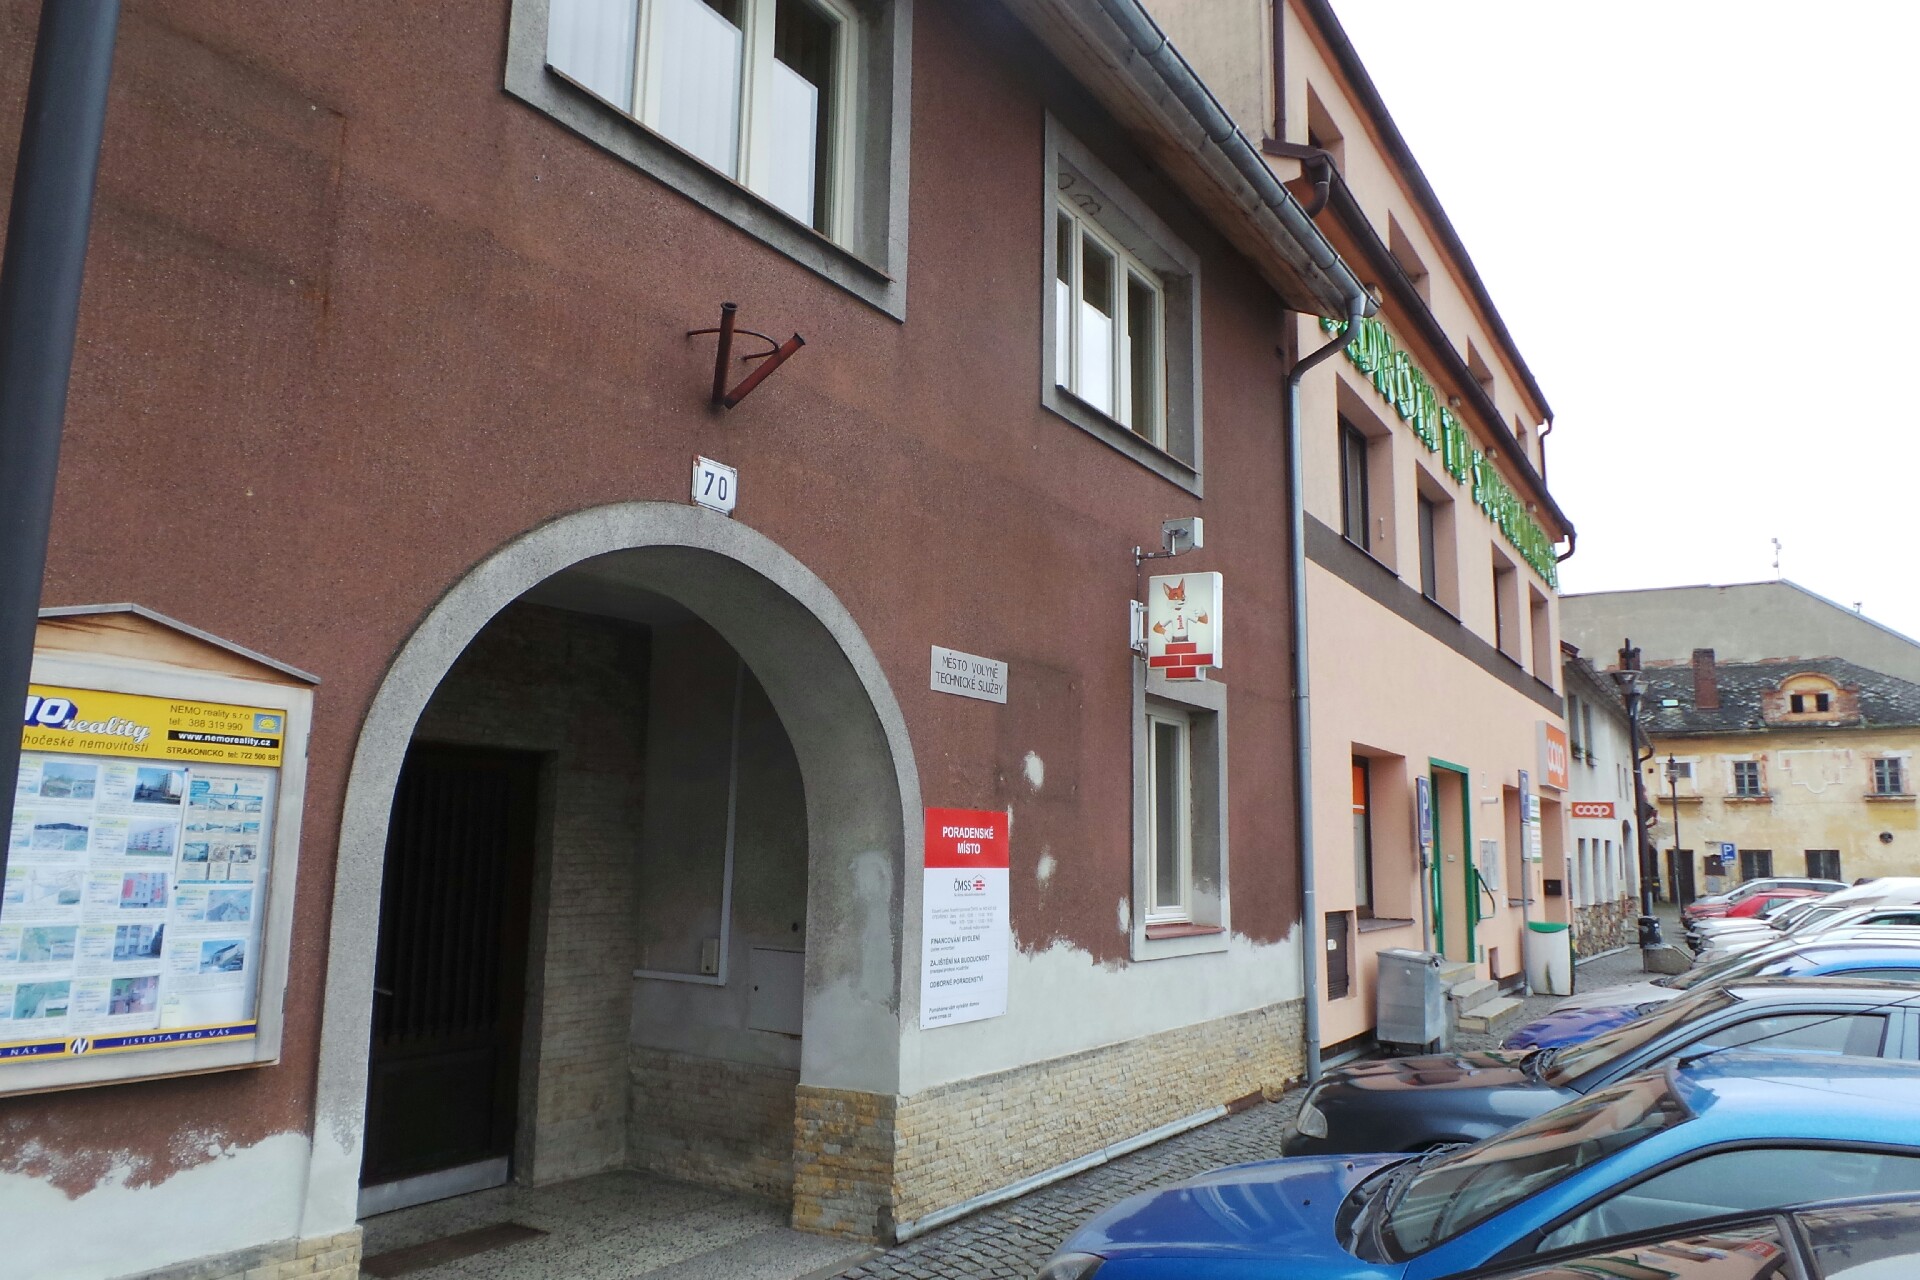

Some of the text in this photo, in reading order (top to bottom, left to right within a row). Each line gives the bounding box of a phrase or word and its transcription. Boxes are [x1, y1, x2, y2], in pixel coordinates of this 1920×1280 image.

[704, 470, 727, 501] 70
[942, 652, 999, 679] MĚSTO VOLYNĚ
[935, 671, 1004, 695] TECHNICKÉ SLUŽBY
[170, 705, 201, 715] NEMO
[203, 709, 230, 719] reality
[63, 717, 150, 743] reality
[188, 718, 206, 728] 388
[227, 722, 243, 731] 990
[79, 739, 149, 753] nemovitosti
[178, 731, 271, 747] www.nemoreality.cz
[166, 746, 224, 757] STRAKONICKO
[1575, 804, 1610, 818] coop
[942, 826, 994, 840] PORADENSKÉ
[957, 840, 981, 855] MÍSTO
[1723, 844, 1733, 856] P
[953, 878, 972, 892] ČMSS
[930, 934, 981, 945] FINANCOVÁNÍ BYDLENÍ
[930, 958, 953, 967] ZAJIŠTĚNÍ
[929, 974, 984, 989] ODBORNÉ PORADENSTVÍ
[180, 1031, 202, 1040] PRO
[208, 1028, 230, 1037] VÁS
[10, 1046, 38, 1056] NÁS
